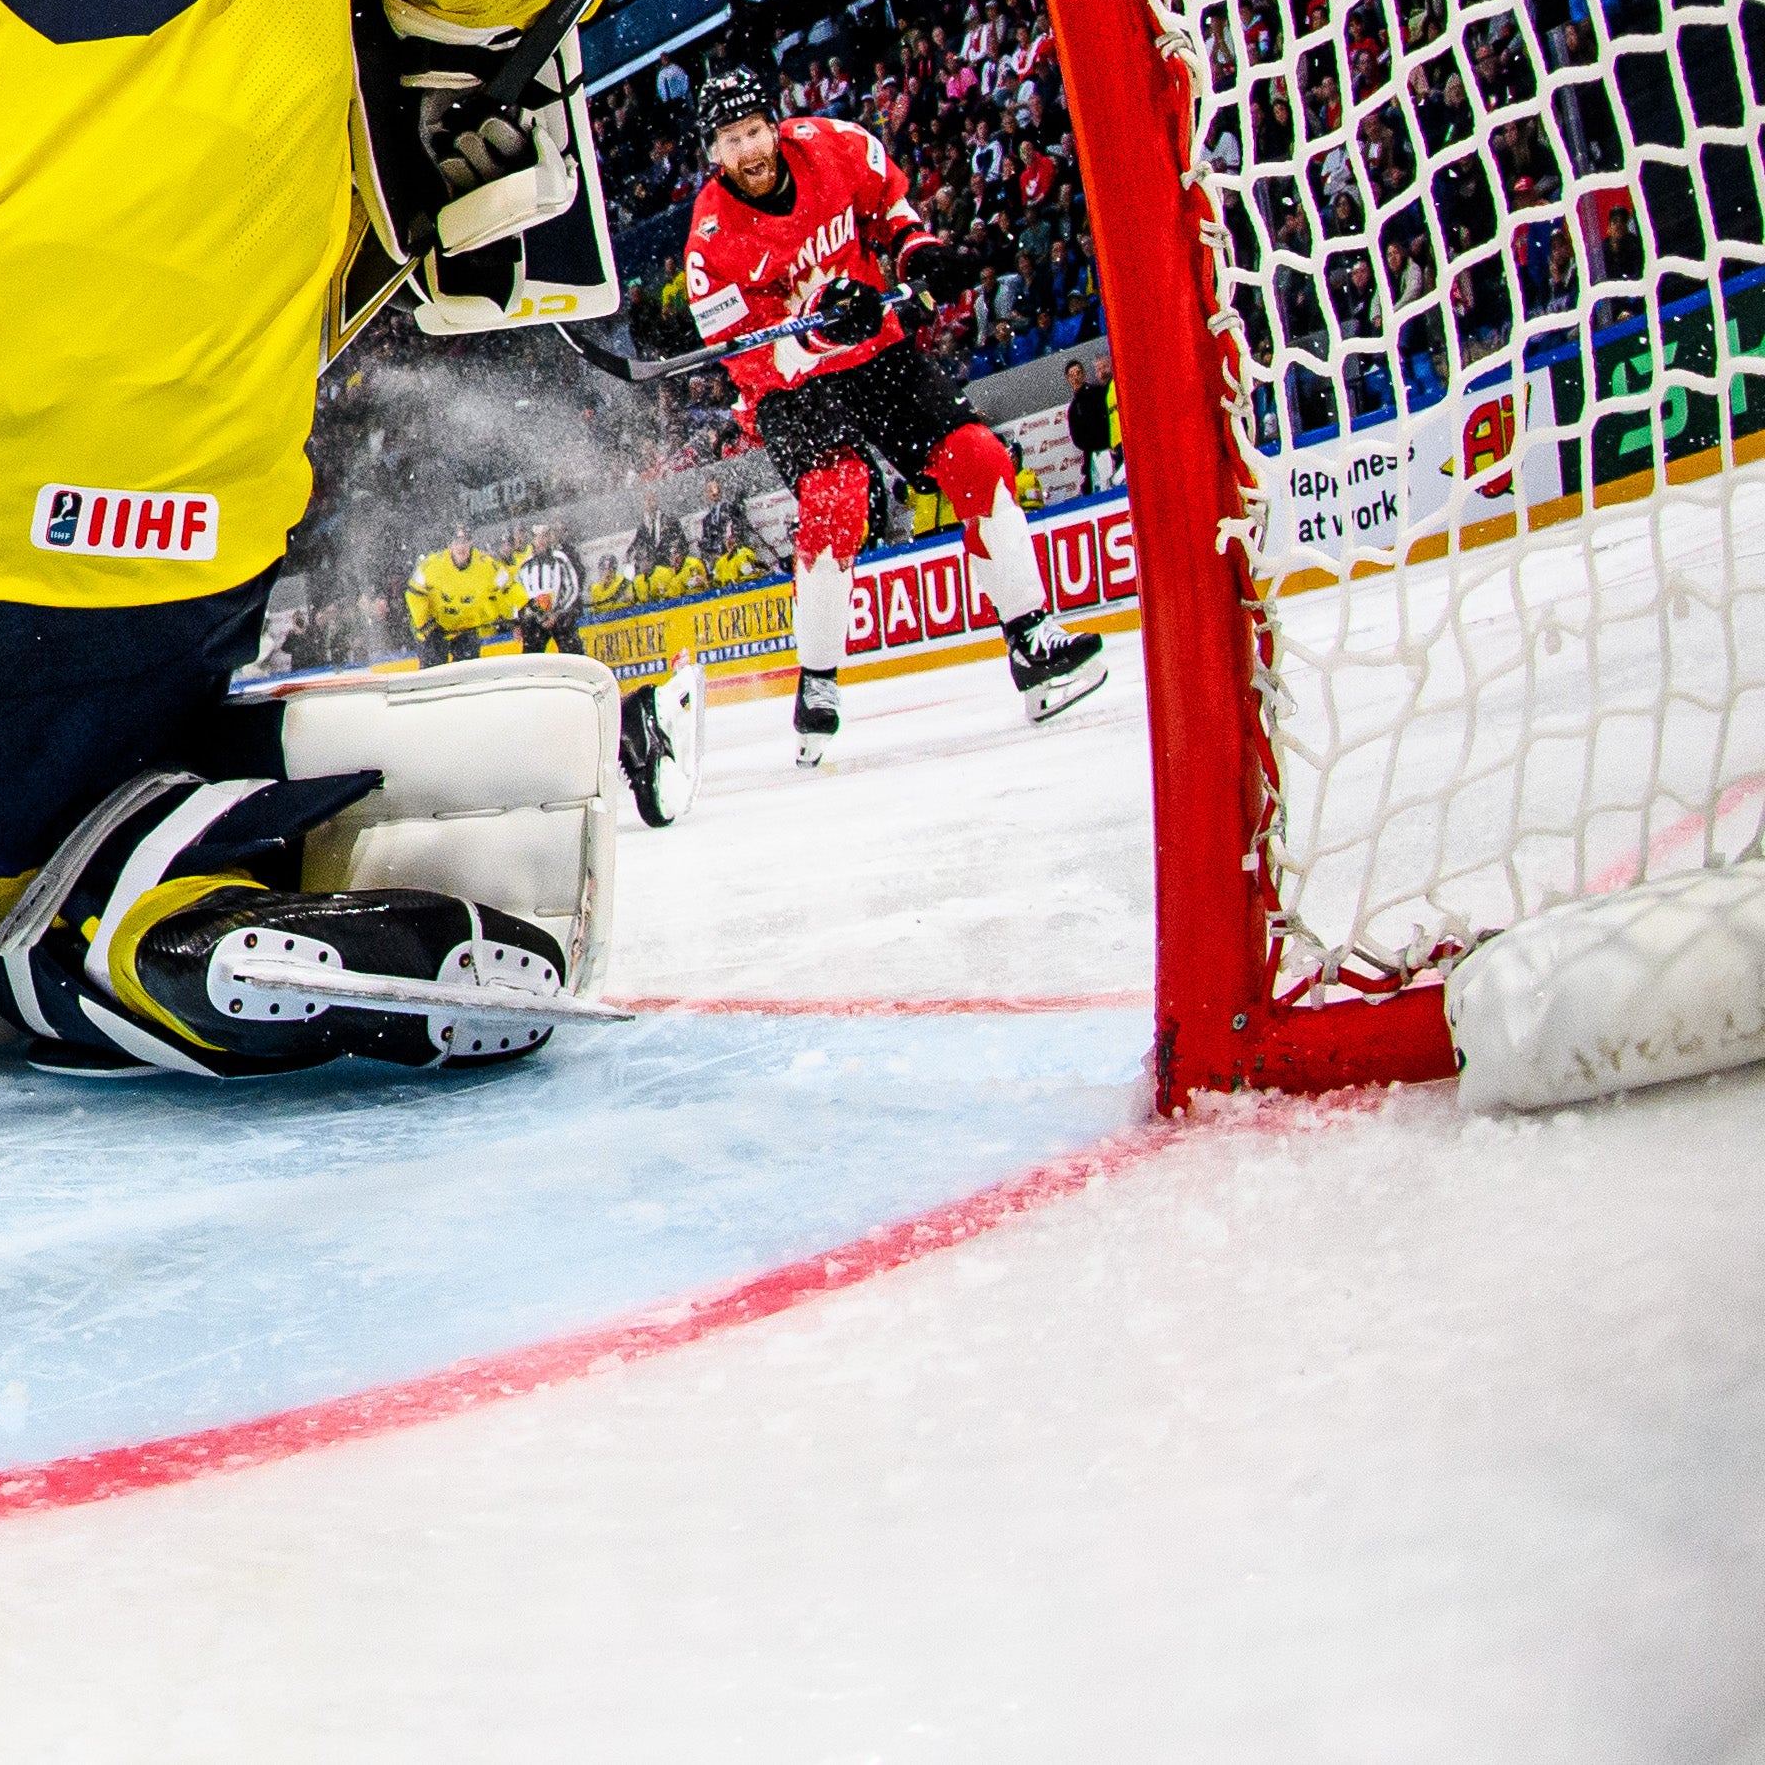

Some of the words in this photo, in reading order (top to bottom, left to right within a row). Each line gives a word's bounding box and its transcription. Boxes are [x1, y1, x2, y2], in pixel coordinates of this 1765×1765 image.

[722, 91, 757, 110] TELUS
[788, 204, 856, 285] ANADA
[50, 530, 71, 540] IIHF
[87, 496, 207, 551] IIHF
[1299, 511, 1326, 543] at
[848, 521, 1138, 643] BAUUS
[694, 611, 713, 646] LE
